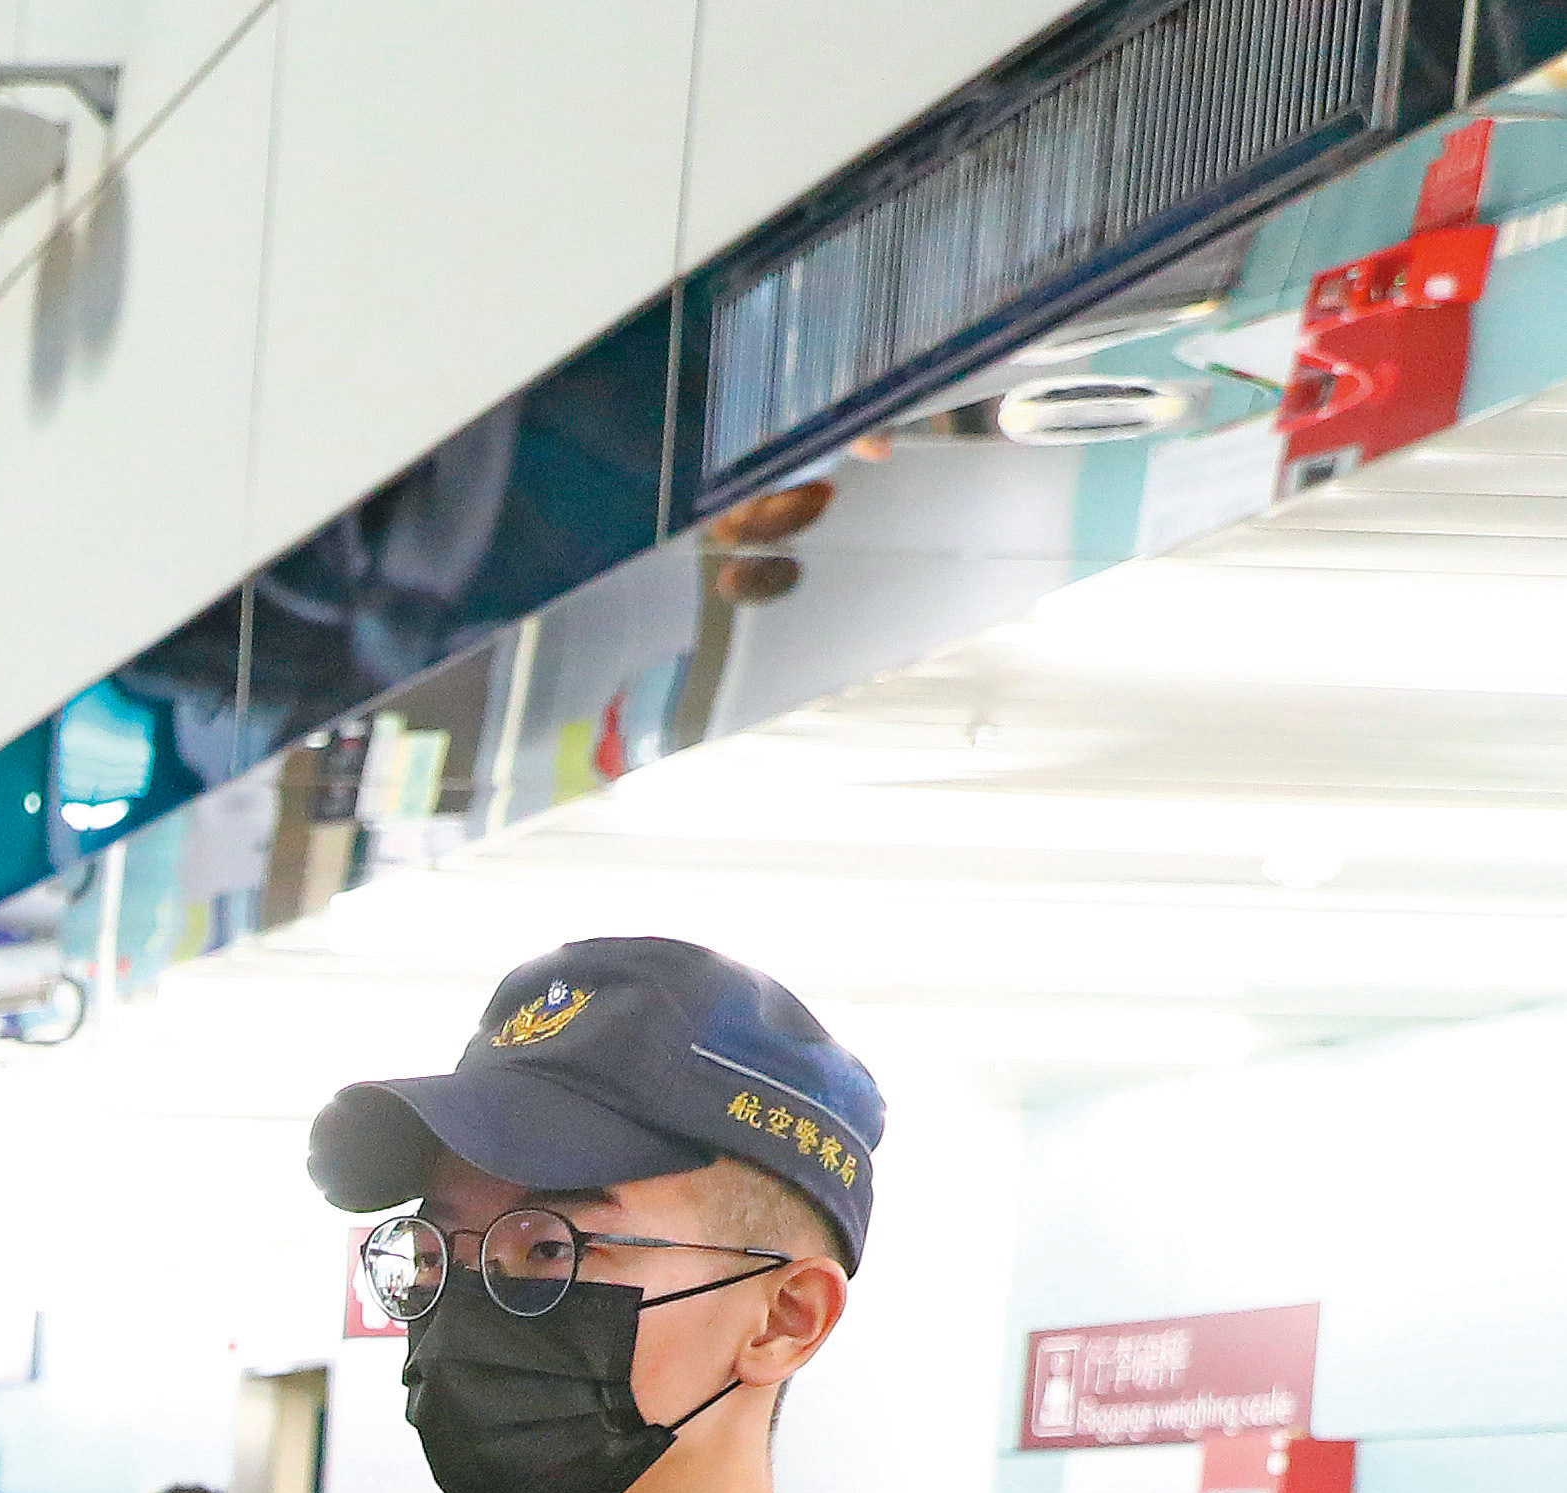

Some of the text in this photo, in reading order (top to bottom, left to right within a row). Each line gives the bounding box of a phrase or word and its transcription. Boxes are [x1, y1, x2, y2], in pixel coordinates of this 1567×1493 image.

[727, 1091, 858, 1190] 航空警察局
